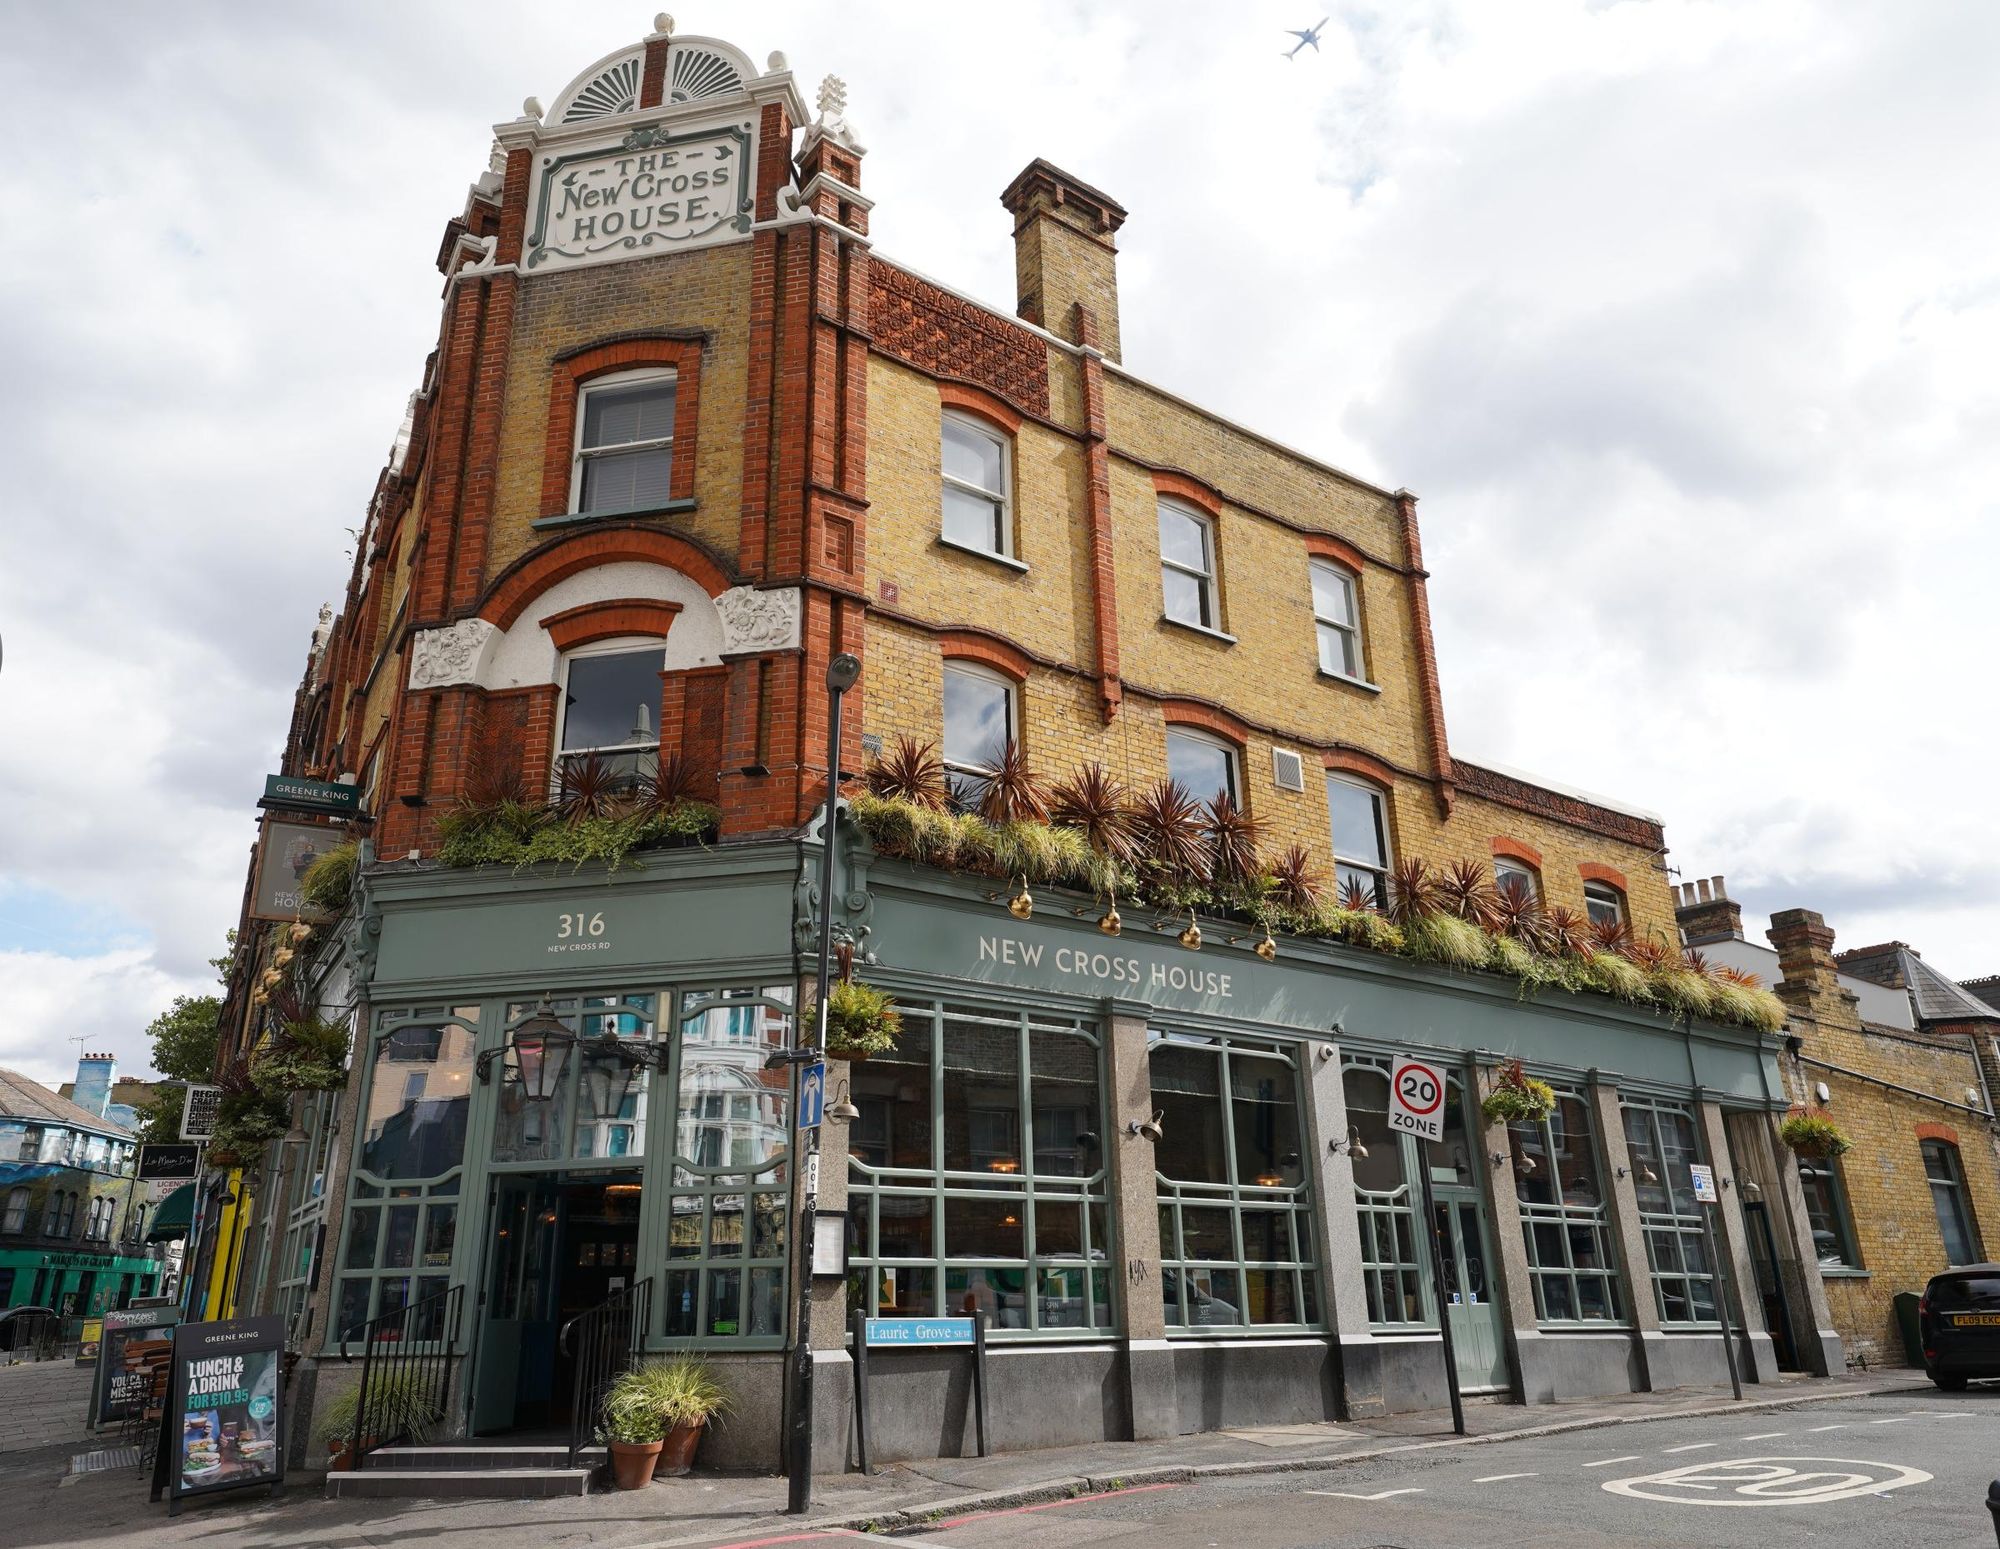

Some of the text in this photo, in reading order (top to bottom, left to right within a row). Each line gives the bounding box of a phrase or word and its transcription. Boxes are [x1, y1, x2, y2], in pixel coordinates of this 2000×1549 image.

[614, 151, 679, 177] THE
[556, 167, 729, 219] New Cross
[572, 196, 719, 242] HOUSE.
[276, 784, 318, 797] GREENE
[322, 790, 350, 801] KING
[557, 912, 605, 938] 316
[547, 941, 611, 953] NEW CROSS RD
[979, 935, 1233, 997] NEW CROSS HOUSE
[1402, 1076, 1436, 1103] 20
[1393, 1112, 1437, 1136] ZONE
[1046, 1301, 1059, 1310] SPIN
[870, 1324, 909, 1339] Laurie
[916, 1324, 951, 1339] Grove
[1956, 1316, 1980, 1325] FL09
[205, 1331, 259, 1343] GREENE KING
[189, 1356, 244, 1379] LUNCH &
[188, 1373, 242, 1396] A DRINK
[188, 1388, 249, 1410] FOR £10.95
